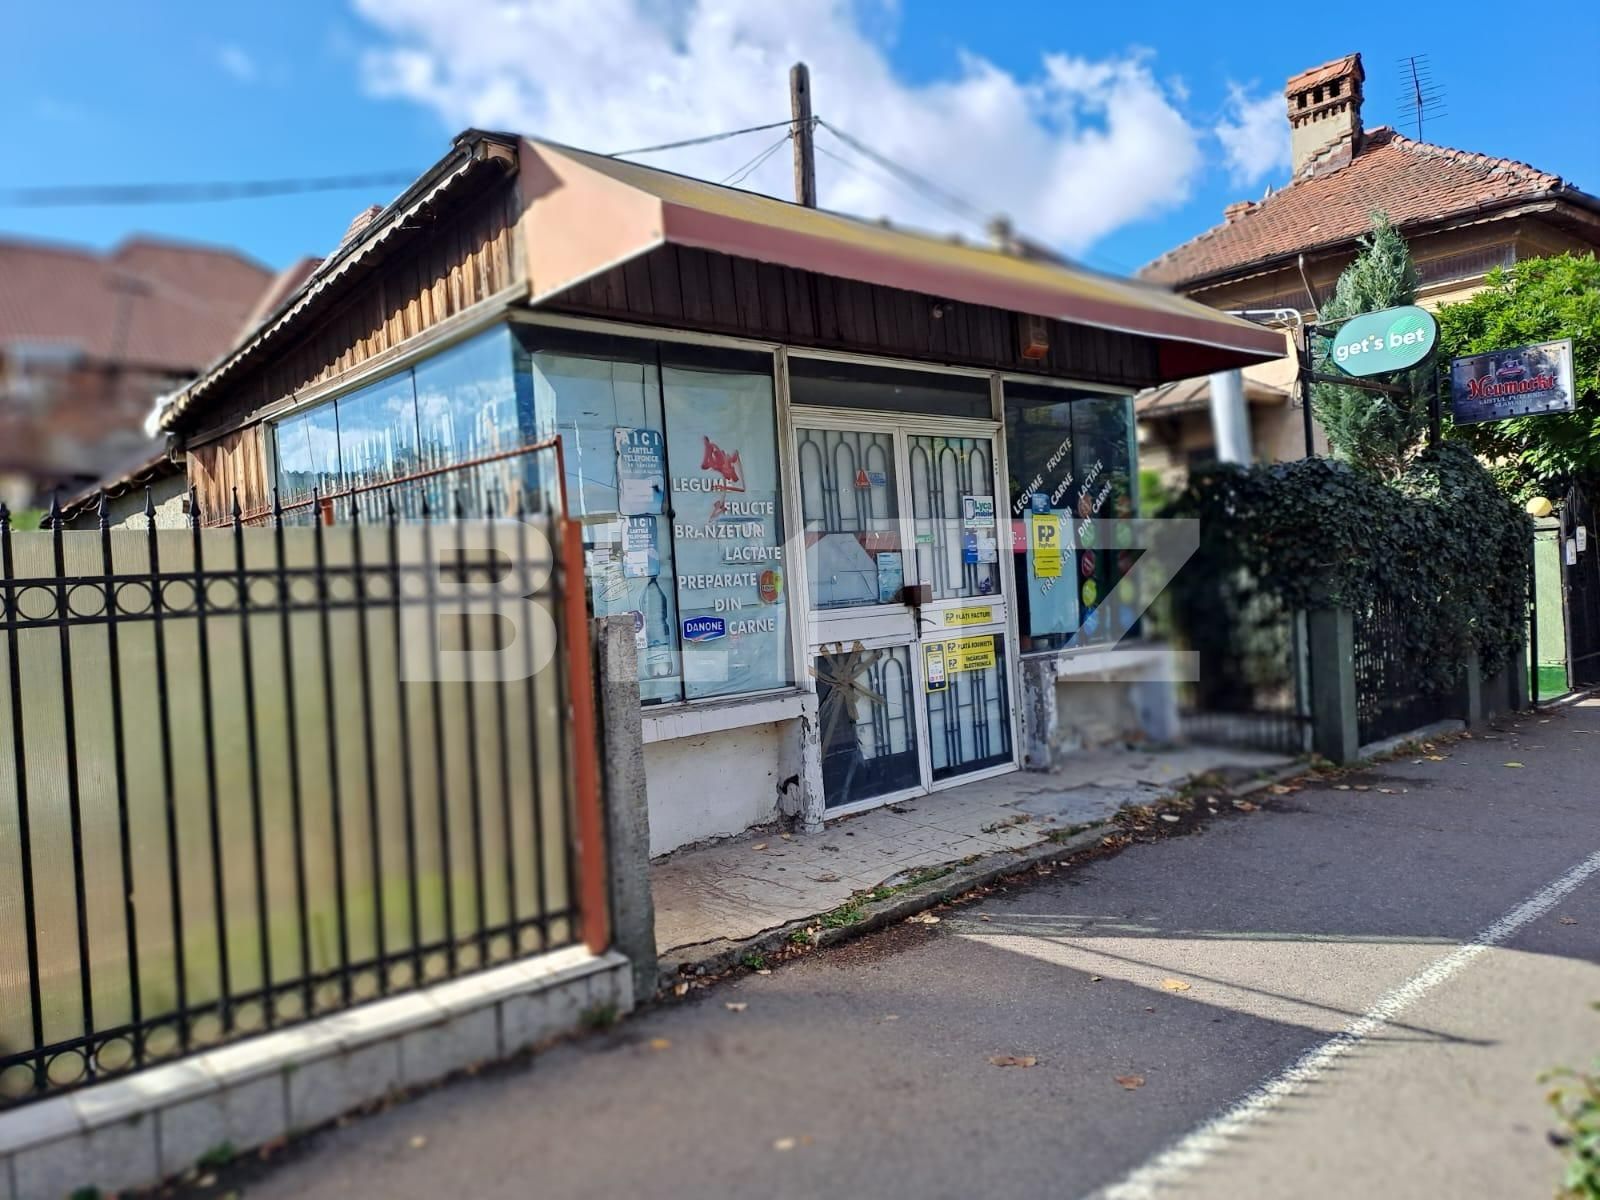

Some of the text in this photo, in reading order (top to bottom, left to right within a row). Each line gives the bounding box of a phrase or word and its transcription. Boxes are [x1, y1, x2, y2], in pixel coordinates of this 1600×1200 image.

[1336, 328, 1425, 362] get's bet
[1467, 373, 1557, 400] Neumarkt
[620, 431, 659, 446] AICI
[1013, 473, 1044, 515] LEGUME
[1046, 437, 1073, 473] FRUCTE
[1077, 459, 1104, 499] LACTATE
[1050, 472, 1074, 506] CARNE
[724, 501, 774, 515] FRUCTE
[974, 501, 992, 512] Lyca
[1078, 515, 1092, 537] DIN
[1092, 479, 1113, 514] CARNE
[725, 546, 782, 560] LACTATE
[678, 572, 758, 590] PREPARATE
[714, 598, 742, 612] DIN
[686, 621, 723, 633] DANONE
[729, 618, 775, 635] CARNE
